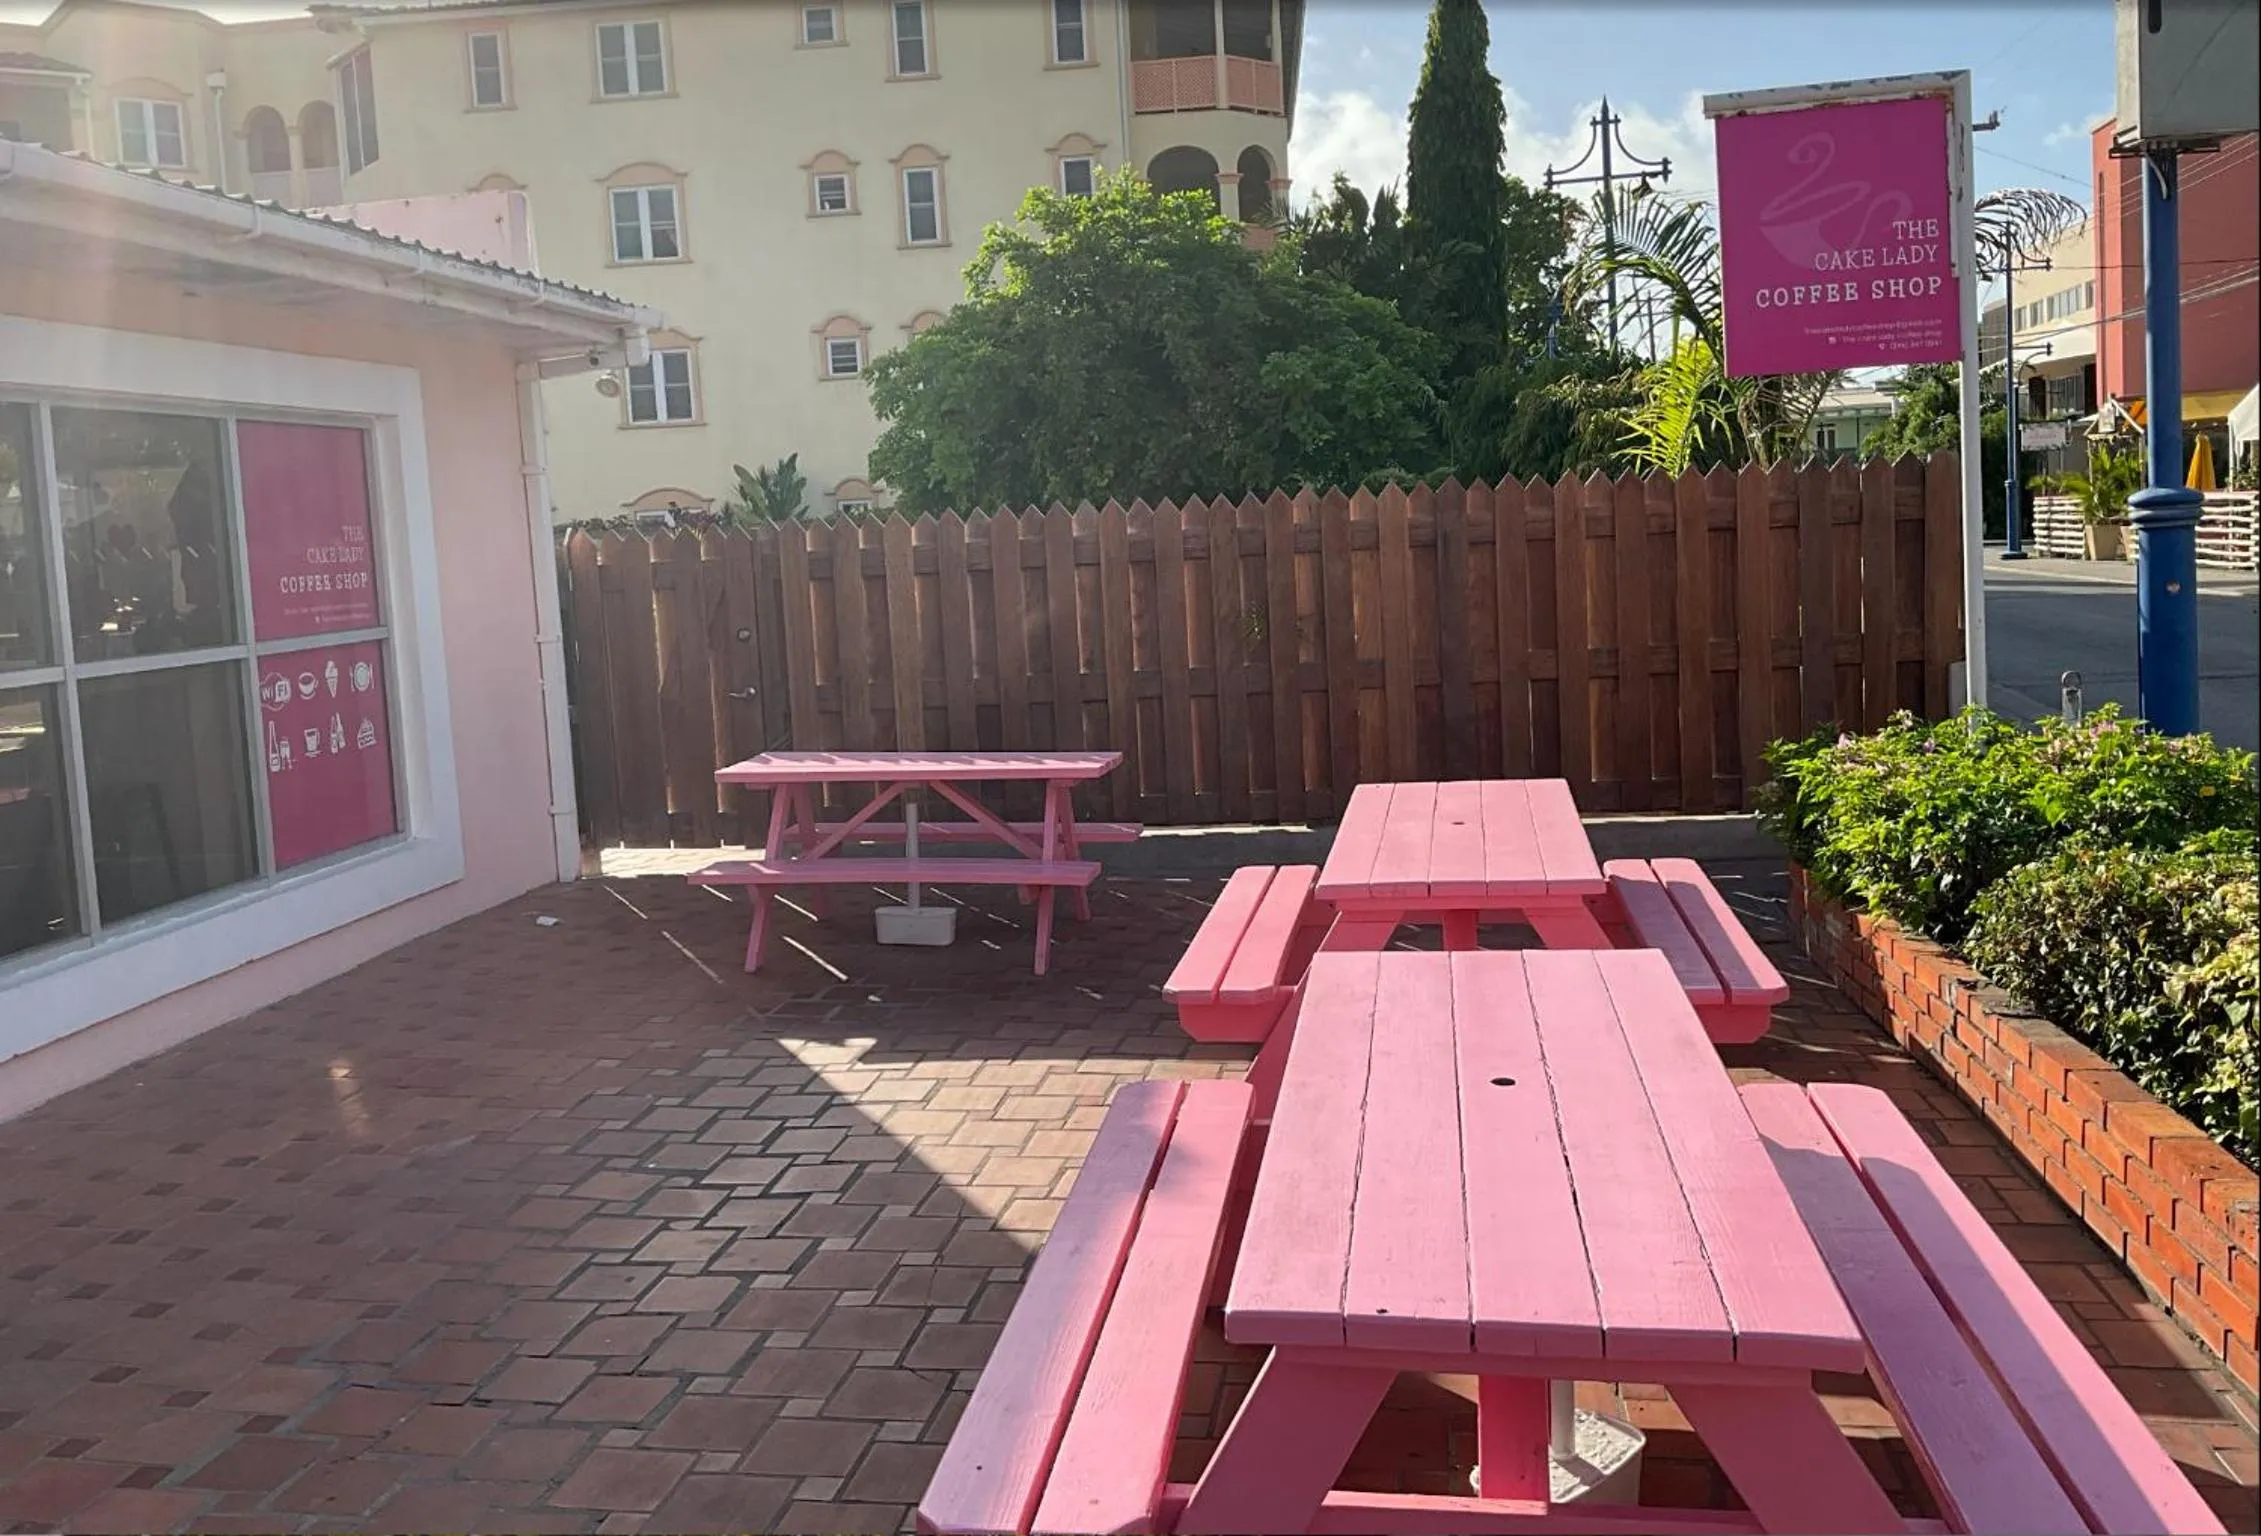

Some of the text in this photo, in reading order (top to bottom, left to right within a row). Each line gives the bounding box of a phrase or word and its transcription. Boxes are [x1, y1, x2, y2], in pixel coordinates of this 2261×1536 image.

[1893, 219, 1940, 240] THE
[1815, 244, 1938, 271] CAKE LADY
[1756, 277, 1942, 308] COFFEE SHOP
[342, 525, 365, 542] THE
[307, 546, 364, 563] CAKE LADY
[280, 571, 367, 593] COFFEE SHOP
